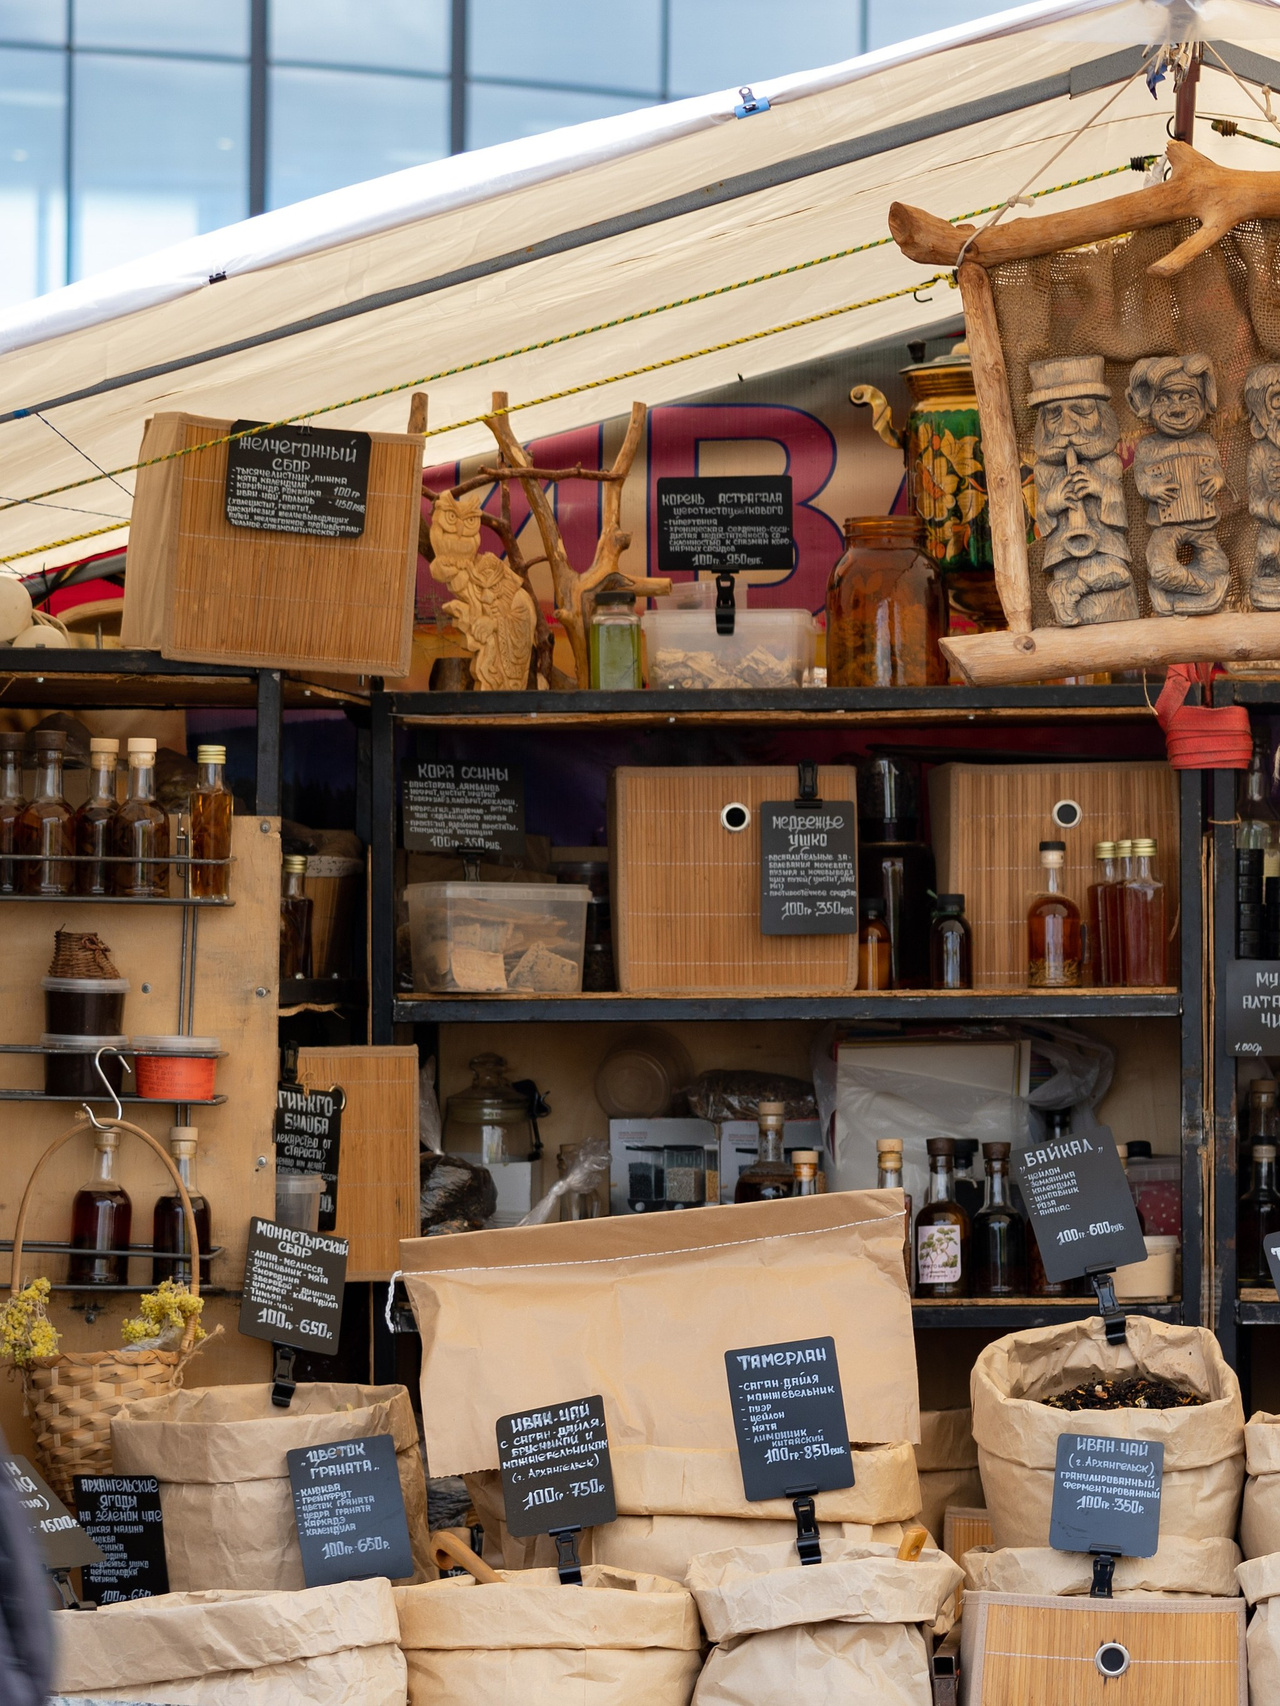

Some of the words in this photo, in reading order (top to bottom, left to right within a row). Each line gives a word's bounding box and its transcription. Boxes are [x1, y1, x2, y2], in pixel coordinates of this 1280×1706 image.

[272, 458, 311, 472] СБОР
[662, 493, 705, 506] КОРЕНЬ
[718, 492, 783, 504] АСТРАГАЛА
[418, 763, 455, 779] КОРА
[461, 766, 509, 781] ОСИНЫ
[772, 815, 845, 833] МЕДВЕЖЬЕ
[788, 833, 828, 854] УШКО
[323, 1138, 332, 1150] ОТ
[1036, 1200, 1057, 1209] РОЗА
[1039, 1204, 1071, 1216] АНАНАС
[256, 1221, 349, 1256] МОНАСТЫРСКИЙ
[278, 1241, 312, 1258] СБОР
[737, 1347, 827, 1371] ТАМЕРЛАН
[747, 1385, 835, 1402] МОЖЖЕВЕЛЬНИК
[749, 1404, 772, 1413] ПУЭР
[750, 1412, 785, 1424] ЦЕЙЛОН
[752, 1423, 777, 1433] МЯТА
[754, 1428, 807, 1443] ЛИМОННИК
[772, 1429, 824, 1447] КИТАЙСКИЙ
[500, 1440, 508, 1448] С
[81, 1478, 159, 1493] АРХАНГЕЛЬСКИЕ
[1060, 1472, 1155, 1489] ГРАНУЛИРОВАННЫЙ
[300, 1483, 340, 1496] КЛЮКВА
[1063, 1481, 1160, 1499] ФЕРМЕНТИРОВАННЫЙ
[100, 1495, 137, 1510] ЯГОДЫ
[302, 1490, 352, 1504] ГРЕЙПФРУТ
[302, 1502, 332, 1512] ЦВЕТОК
[336, 1495, 375, 1507] ГРАНАТА
[79, 1511, 92, 1522] НА
[142, 1510, 163, 1522] ЧАЕ
[303, 1511, 330, 1520] ЦЕДРА
[335, 1504, 371, 1516] ГРАНАТА
[86, 1525, 111, 1534] ДИКАЯ
[114, 1525, 144, 1533] МАЛИНА
[304, 1517, 346, 1528] КАРКАДЭ
[306, 1523, 356, 1536] КАЛЕНДУЛА
